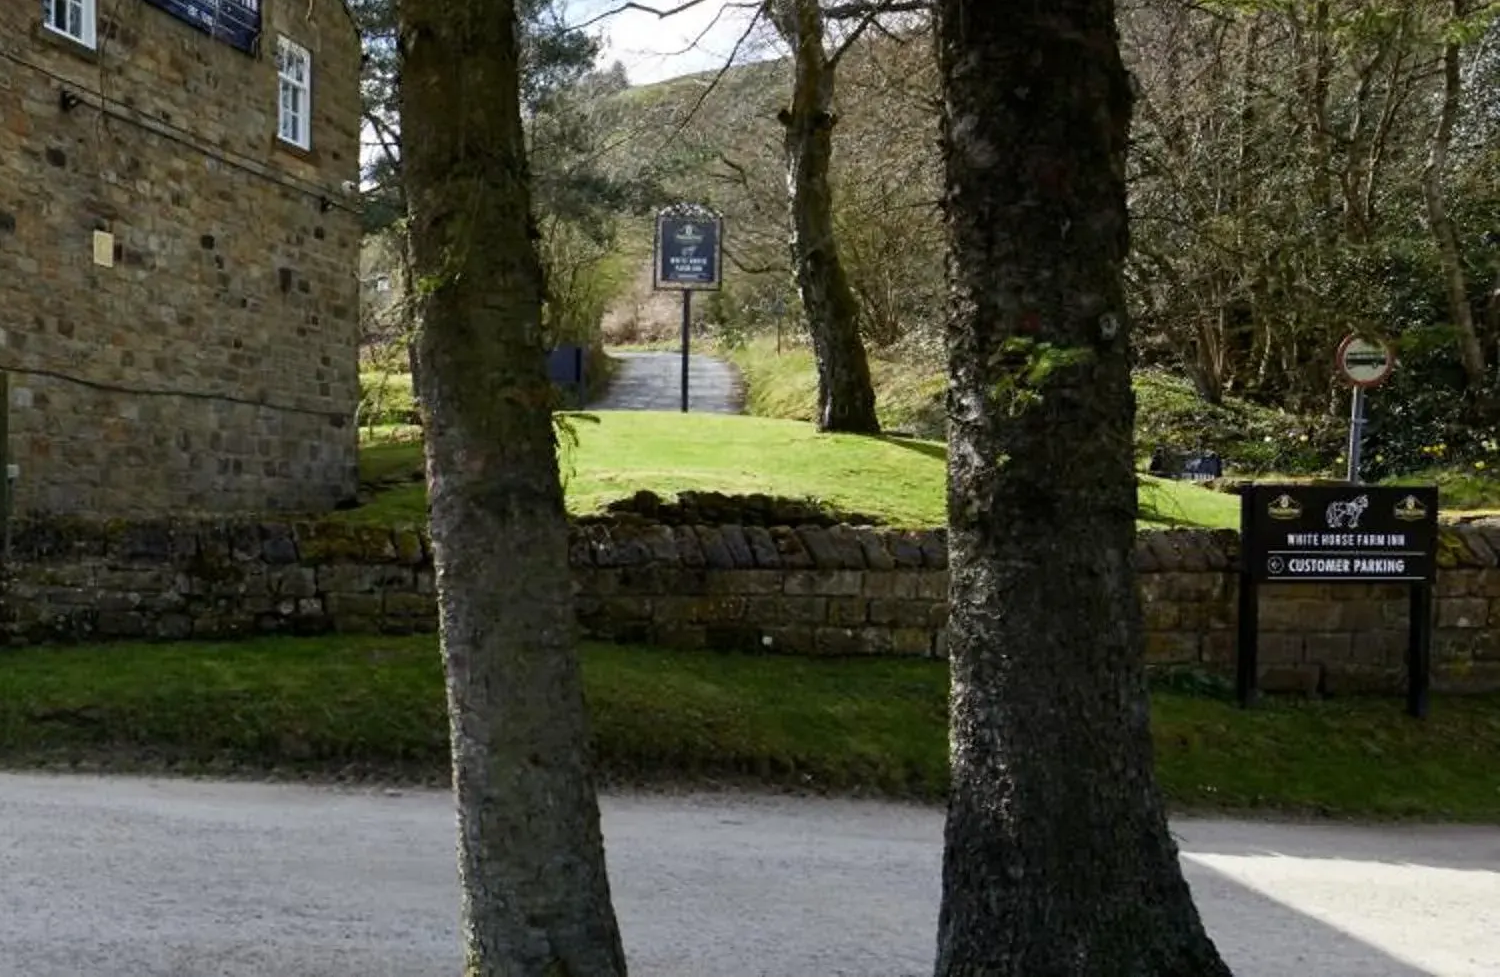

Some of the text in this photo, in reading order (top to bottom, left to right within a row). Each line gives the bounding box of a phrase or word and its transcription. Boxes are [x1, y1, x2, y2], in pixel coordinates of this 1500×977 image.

[1287, 534, 1405, 546] WHITE HORSE FARM INN
[1288, 558, 1405, 572] CUSTOMER PARKING
